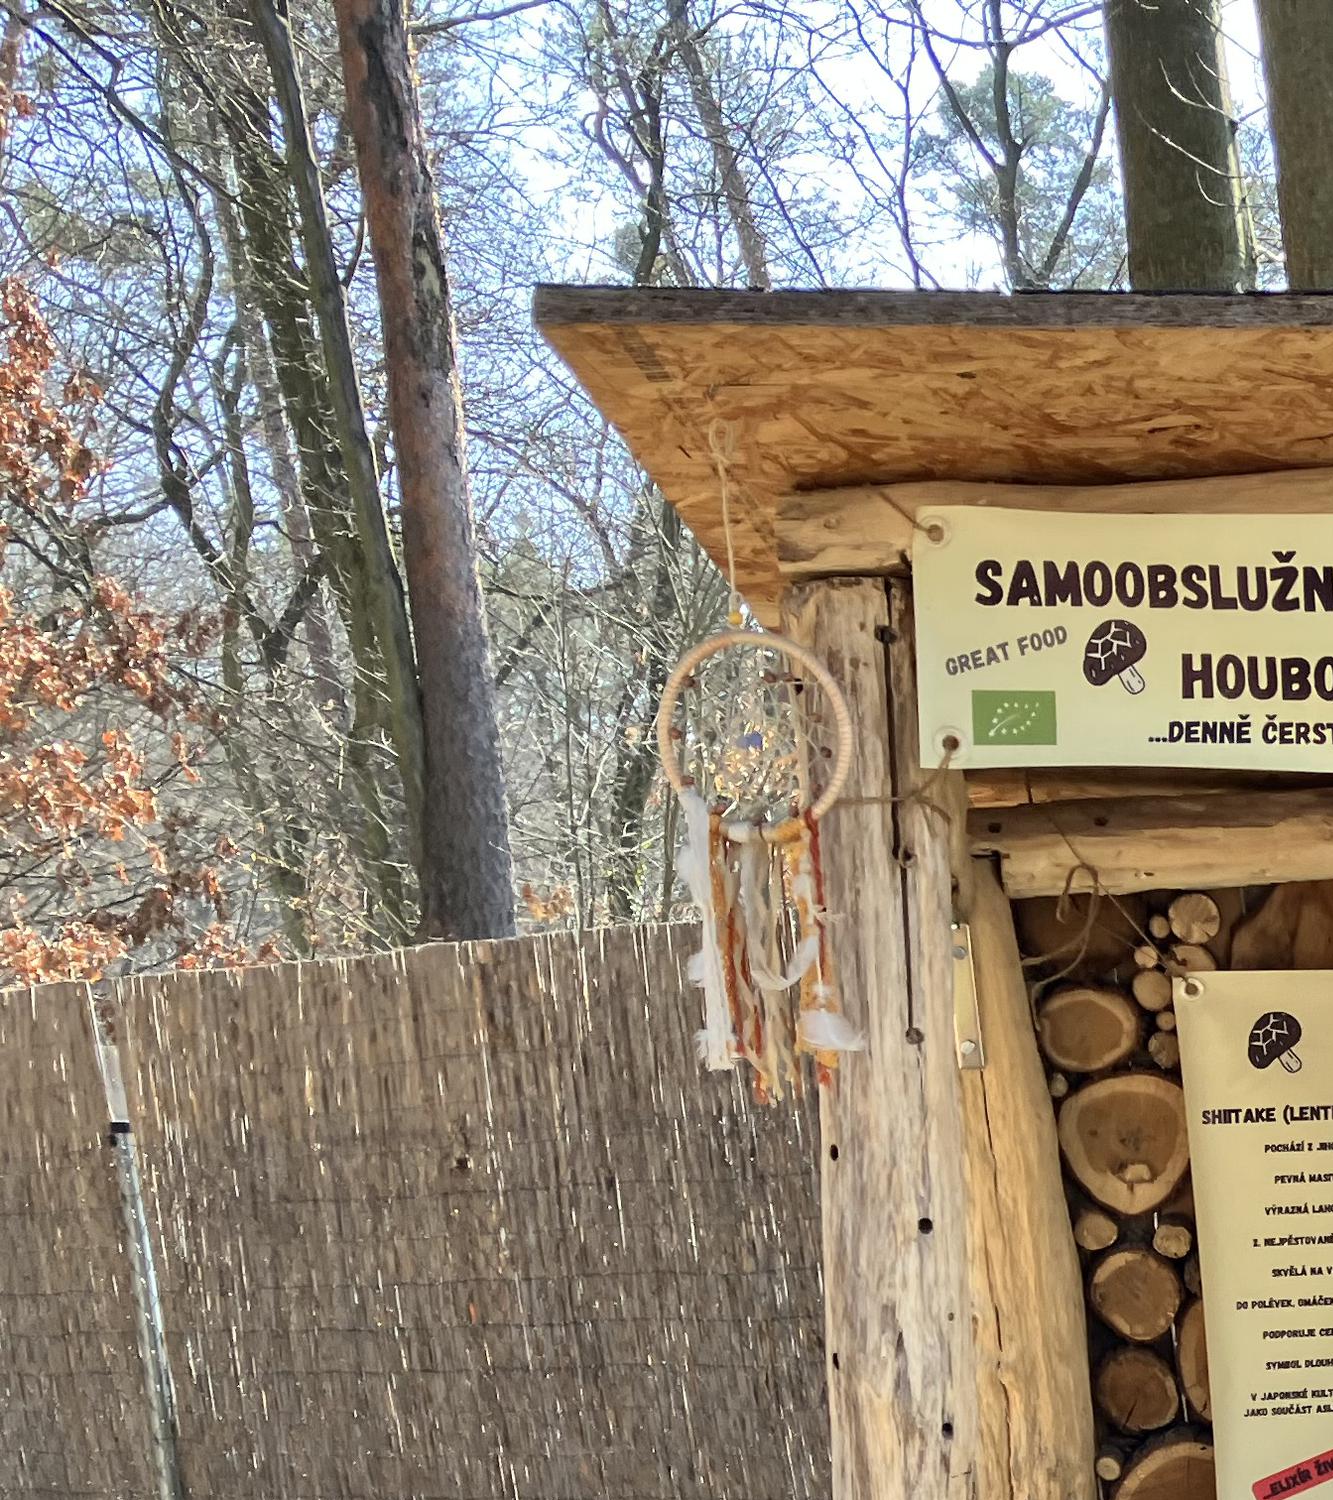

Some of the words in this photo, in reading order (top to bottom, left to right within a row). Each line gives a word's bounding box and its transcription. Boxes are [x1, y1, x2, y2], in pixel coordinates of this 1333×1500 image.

[944, 641, 1011, 678] GREAT
[1017, 625, 1069, 656] FOOD
[1202, 1107, 1276, 1125] SHIITAKE
[1274, 1172, 1305, 1184] PEVNÁ
[1265, 1202, 1309, 1215] VÝRAZNÁ
[1272, 1265, 1307, 1278] SKVĚLÁ
[1310, 1267, 1323, 1276] NA
[1236, 1302, 1248, 1310] DO
[1263, 1328, 1316, 1340] PODPORUJE
[1244, 1408, 1267, 1418] JAKO
